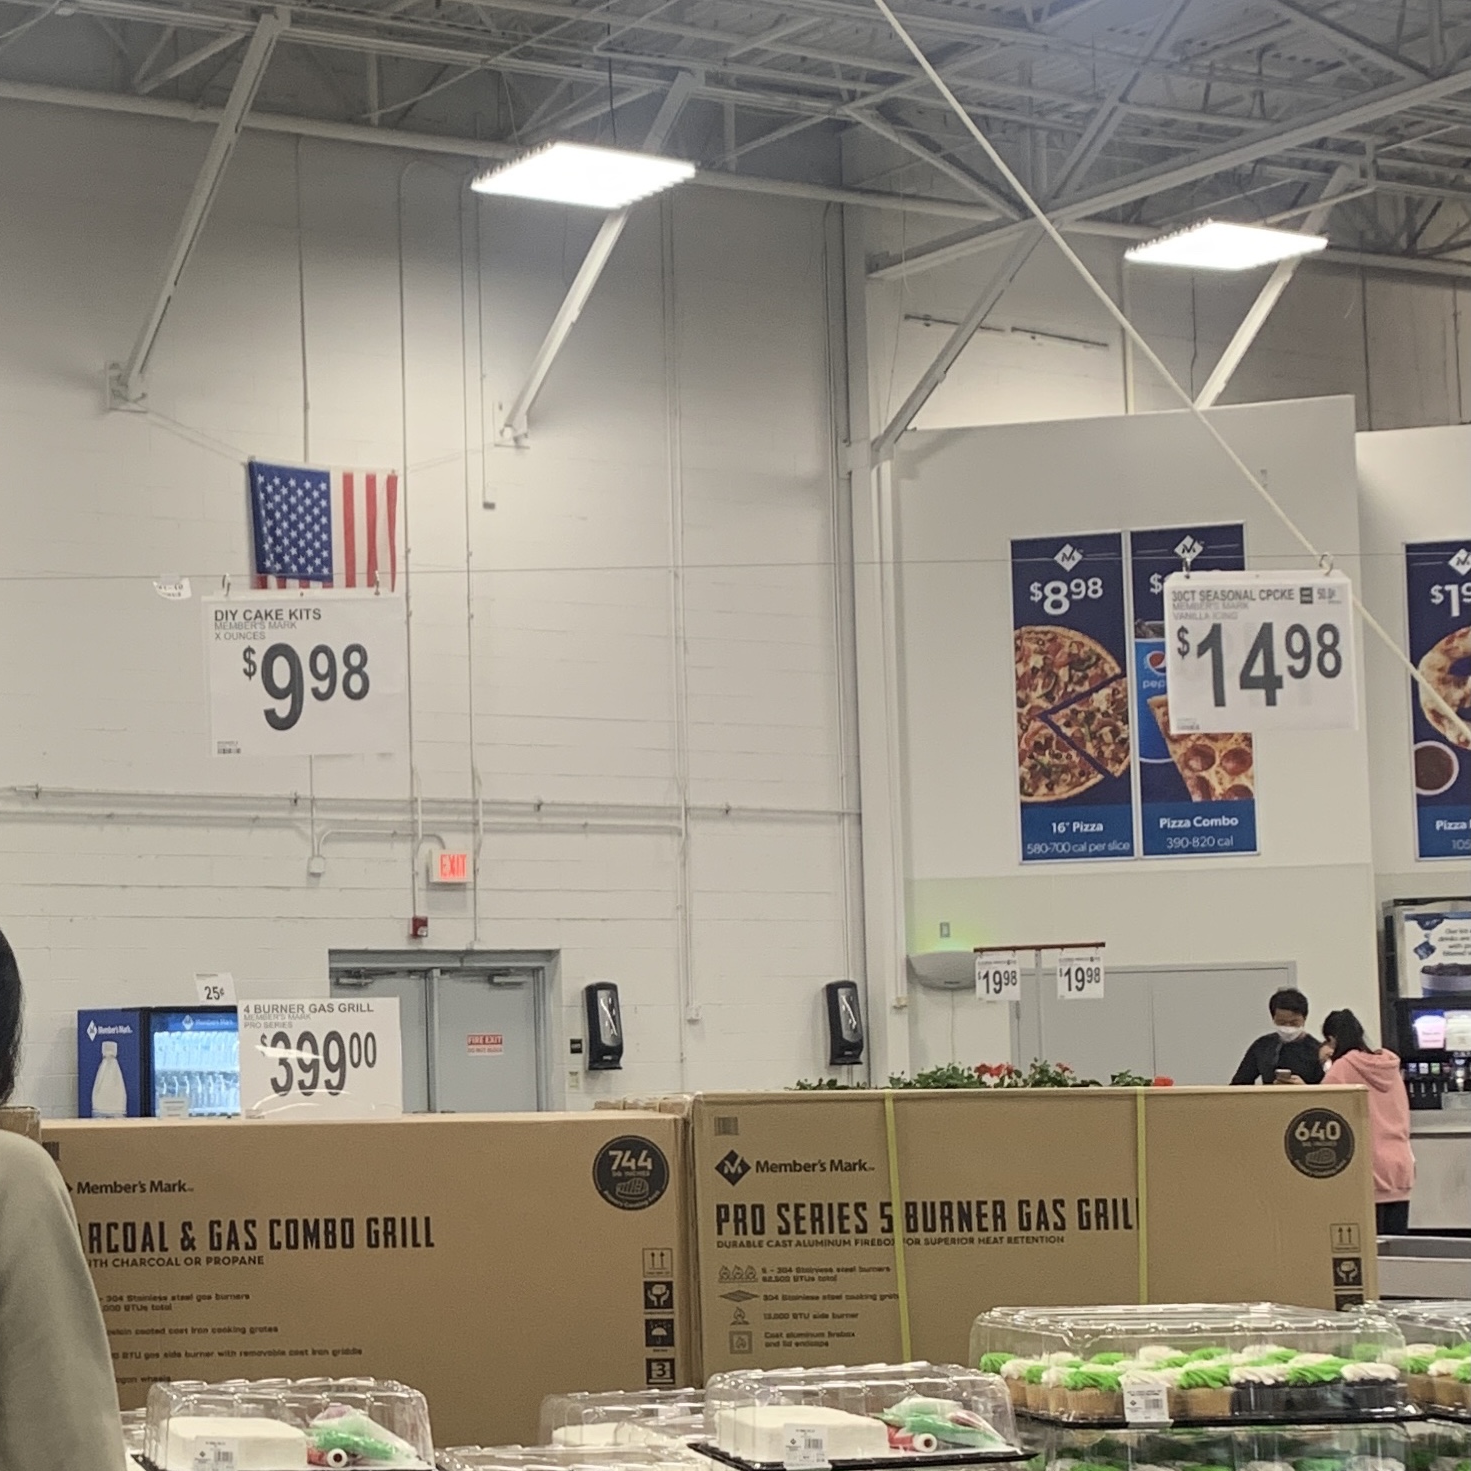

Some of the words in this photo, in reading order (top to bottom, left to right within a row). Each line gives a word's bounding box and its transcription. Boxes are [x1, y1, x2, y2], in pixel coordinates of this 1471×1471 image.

[1030, 577, 1104, 616] $898
[1172, 590, 1197, 601] 30CT
[1198, 589, 1256, 601] SEASONAL
[1259, 588, 1295, 601] CPCKE
[214, 609, 239, 622] DIY
[243, 609, 284, 621] CAKE
[289, 608, 322, 620] KITS
[214, 621, 267, 631] MEMBER'S
[268, 621, 298, 630] MARK
[214, 631, 222, 641] X
[224, 631, 267, 641] OUNCES
[1177, 621, 1343, 708] $1498
[243, 642, 370, 731] $998
[1072, 821, 1104, 833] Pizza
[1159, 817, 1191, 829] Pizza
[1193, 816, 1239, 828] Combo
[1027, 841, 1071, 854] 580-700
[1072, 841, 1087, 852] cal
[1089, 840, 1107, 854] per
[1107, 839, 1131, 851] slice
[1166, 836, 1216, 849] 390-820
[1217, 835, 1234, 846] cal
[243, 1004, 250, 1014] 4
[254, 1003, 305, 1014] BURNER
[308, 1003, 335, 1013] GAS
[338, 1002, 374, 1013] GRILL
[244, 1021, 262, 1029] PRO
[263, 1021, 293, 1029] SERIES
[1295, 1120, 1341, 1141] 640
[609, 1149, 652, 1170] 744
[755, 1160, 826, 1173] Member's
[829, 1159, 868, 1172] Mark
[76, 1181, 147, 1194] Member's
[149, 1180, 187, 1194] Mark
[716, 1203, 766, 1236] PRO
[777, 1201, 868, 1235] SERIES
[880, 1201, 894, 1233] 5
[905, 1199, 1007, 1233] BURNER
[1018, 1198, 1066, 1232] GAS
[180, 1220, 196, 1252] &
[209, 1219, 257, 1251] GAS
[268, 1217, 355, 1250] COMBO
[366, 1216, 435, 1249] GRILL
[716, 1239, 764, 1248] DURABLE
[766, 1239, 793, 1248] CAST
[795, 1238, 851, 1247] ALUMINUM
[923, 1236, 975, 1246] SUPERIOR
[978, 1236, 1004, 1245] HEAT
[1007, 1235, 1065, 1245] RETENTION
[112, 1257, 182, 1268] CHARCOAL
[183, 1257, 202, 1267] OR
[206, 1255, 264, 1267] PROPANE
[656, 1362, 667, 1377] 3
